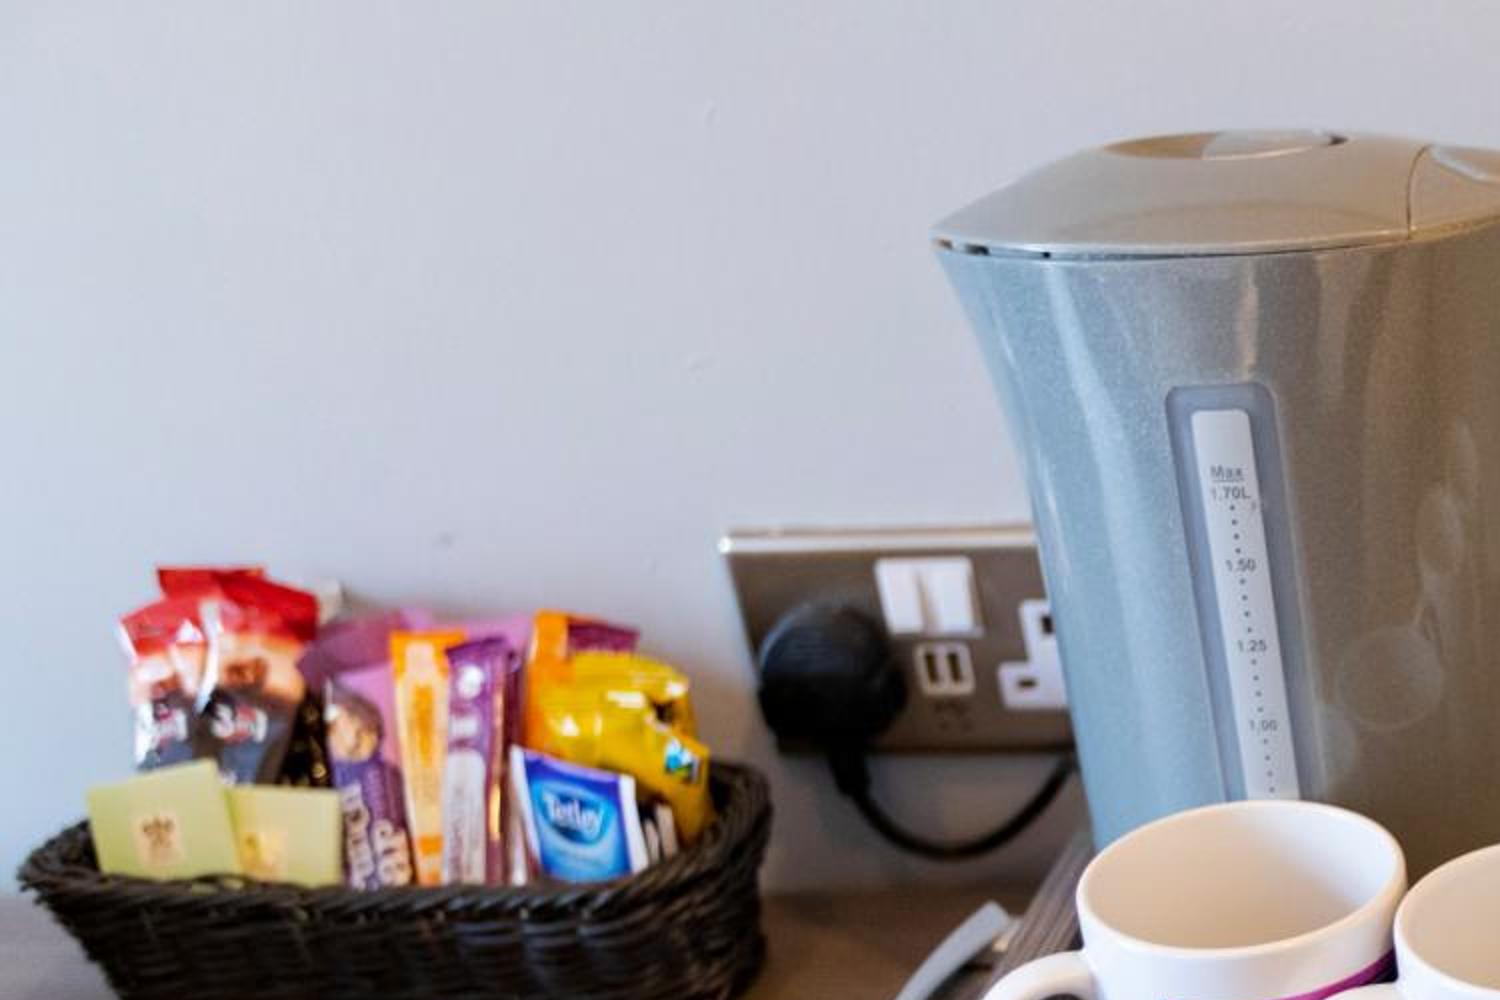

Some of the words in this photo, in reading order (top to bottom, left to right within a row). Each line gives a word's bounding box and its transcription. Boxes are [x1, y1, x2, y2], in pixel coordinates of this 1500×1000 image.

[1210, 465, 1244, 480] Max
[1210, 485, 1251, 500] 1.70L
[1225, 558, 1257, 572] 1.50
[1237, 639, 1268, 652] 1.25
[1248, 719, 1279, 732] 1.00
